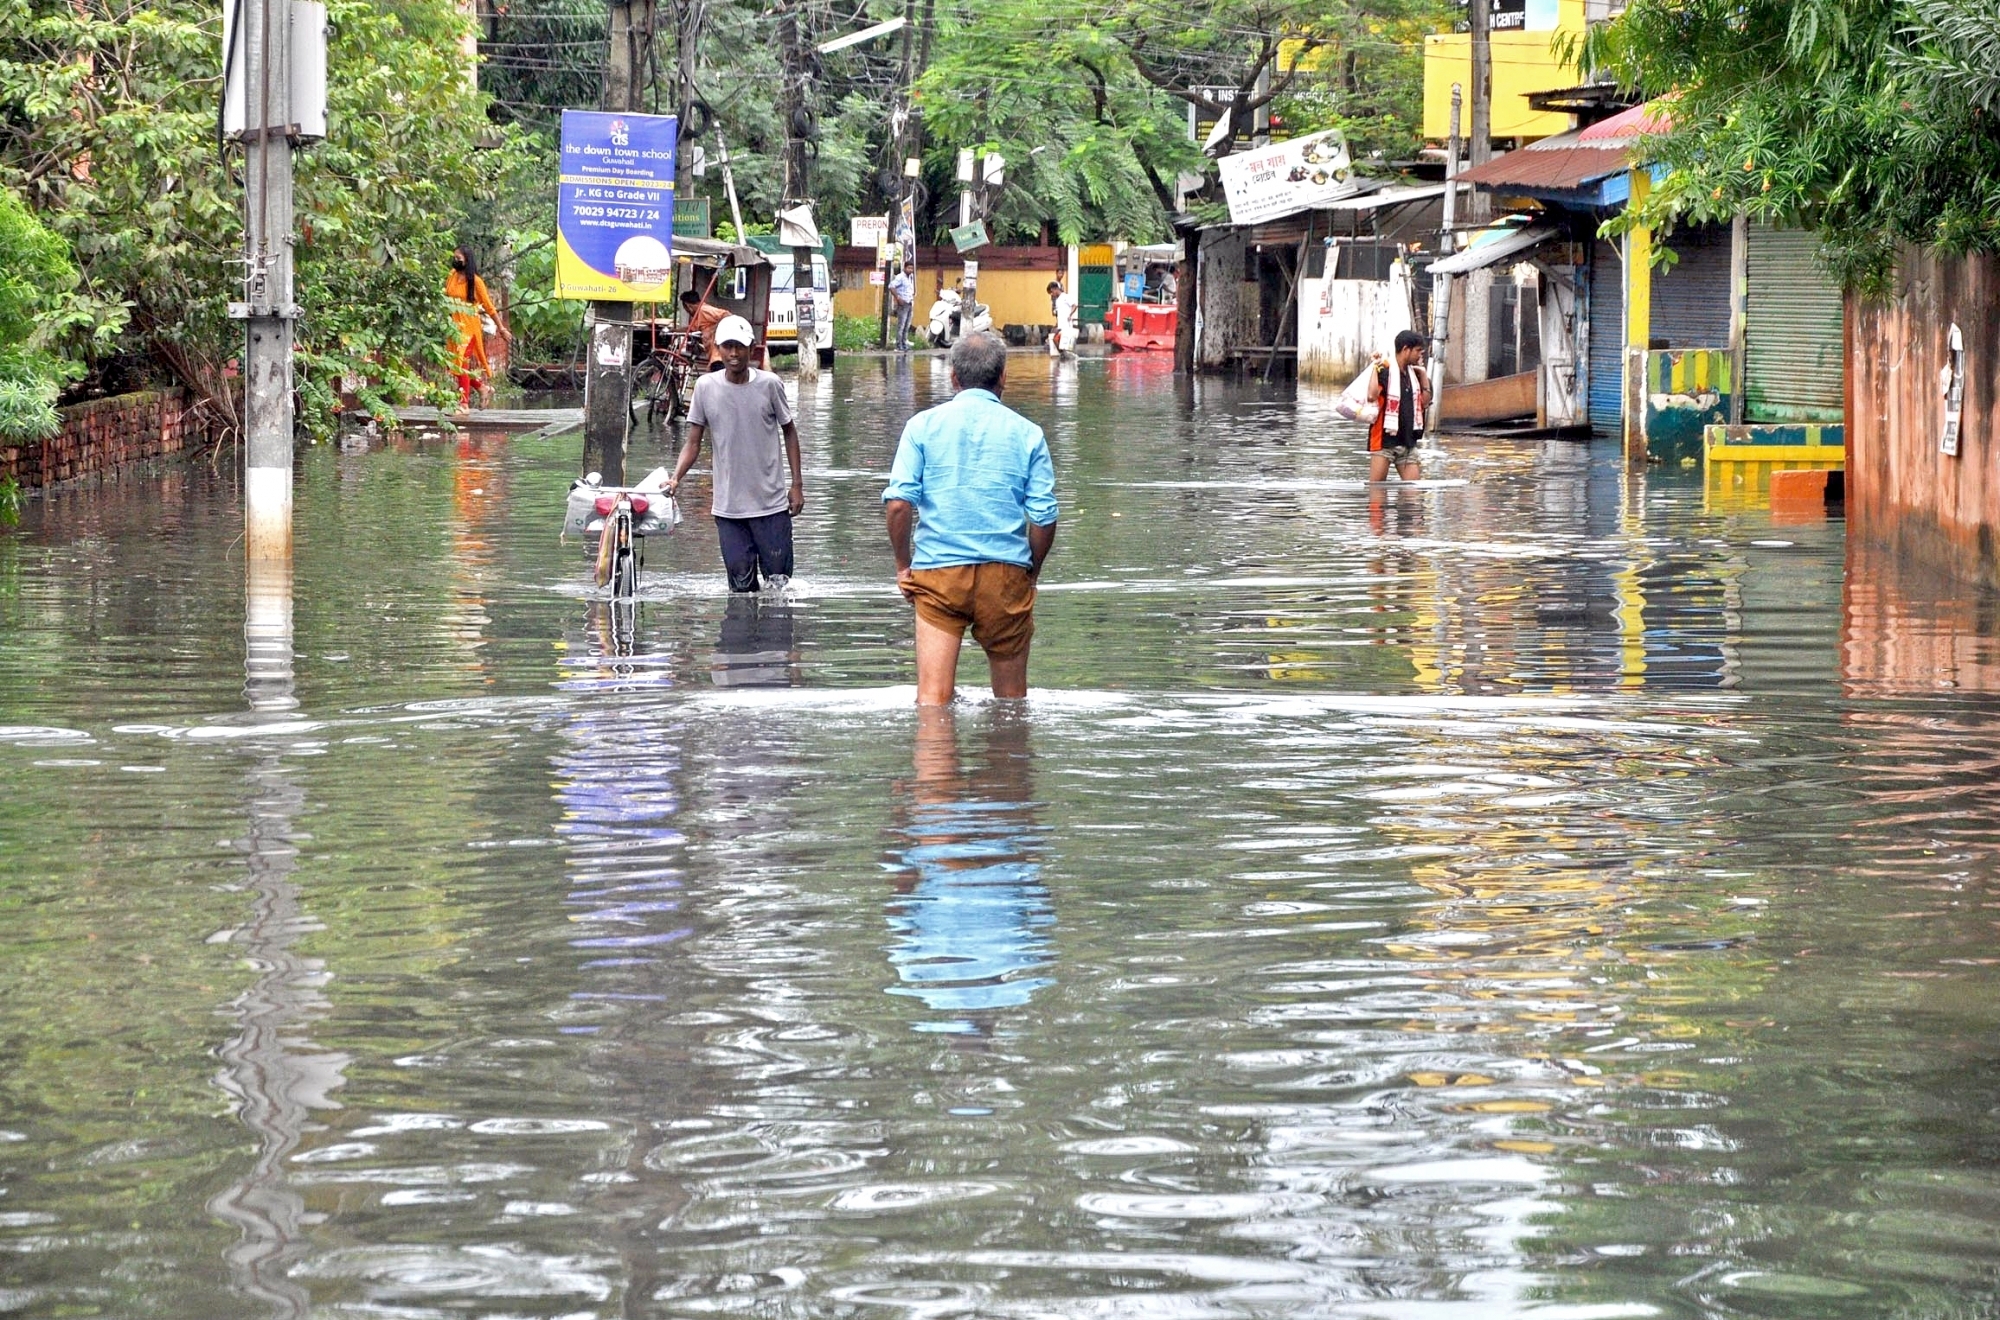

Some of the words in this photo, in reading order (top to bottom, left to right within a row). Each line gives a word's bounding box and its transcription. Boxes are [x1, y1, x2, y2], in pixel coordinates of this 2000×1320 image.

[1496, 11, 1525, 28] CENTRE
[566, 143, 581, 153] the
[583, 144, 611, 156] down
[614, 147, 639, 157] town
[642, 149, 672, 159] school
[602, 156, 635, 165] Guwahati
[582, 165, 611, 174] Premium
[612, 167, 625, 176] Day
[625, 168, 654, 177] Boarding
[564, 176, 613, 185] ADMISSIONS
[575, 187, 586, 198] Jr.
[588, 188, 602, 197] KG
[604, 189, 614, 198] to
[617, 190, 645, 200] Grade
[647, 192, 660, 201] VII
[573, 206, 604, 217] 70029
[606, 207, 638, 218] 94723
[646, 210, 660, 220] 24
[608, 285, 617, 293] 26
